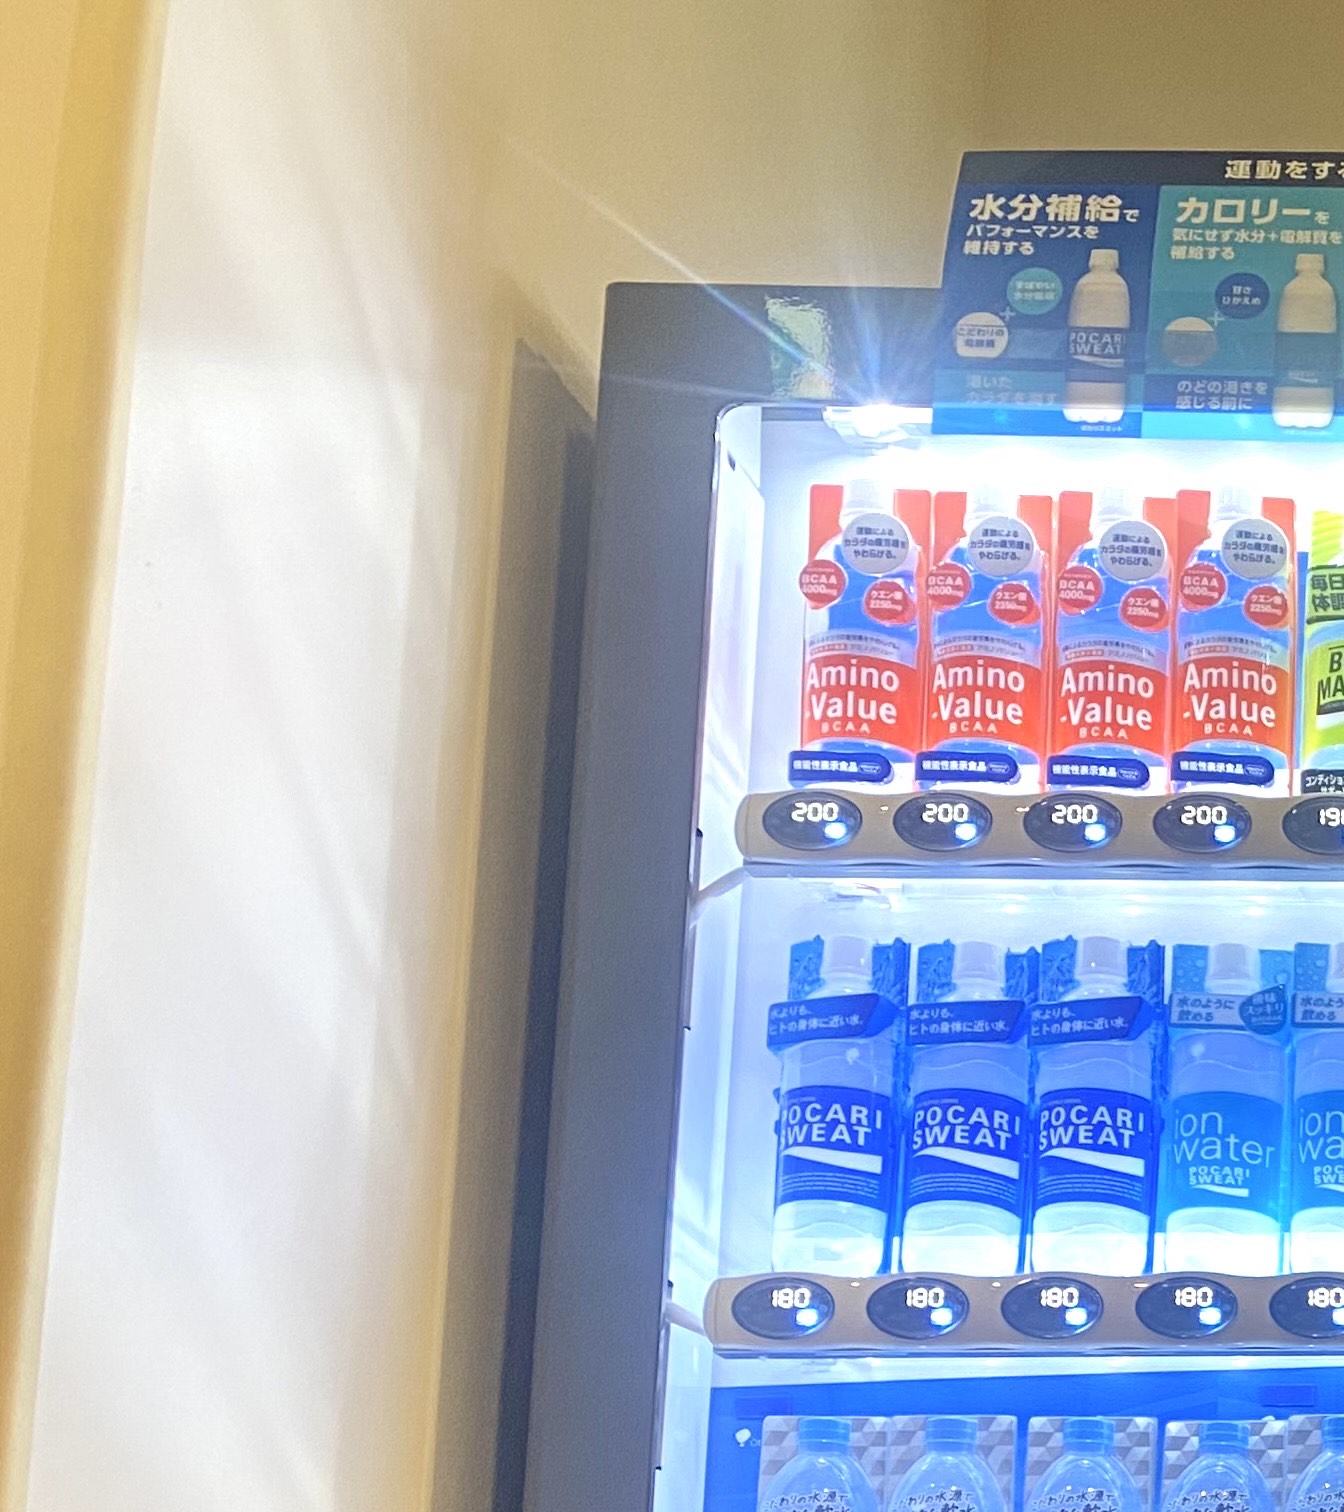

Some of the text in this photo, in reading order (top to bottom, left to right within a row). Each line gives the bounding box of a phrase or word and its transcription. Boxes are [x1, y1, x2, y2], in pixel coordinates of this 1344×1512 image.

[969, 194, 1139, 223] 水分補給で
[1175, 197, 1329, 224] カロリーを
[967, 224, 1099, 239] パフォーマンスを
[962, 241, 1034, 256] 維持する
[1170, 245, 1235, 260] 補給する
[806, 660, 899, 693] Amino
[1060, 665, 1154, 698] Amino
[810, 692, 897, 724] Value
[1067, 697, 1152, 730] Value
[822, 722, 871, 734] BCAA
[1079, 727, 1128, 739] BCAA
[791, 802, 838, 821] 200
[922, 803, 968, 822] 200
[1052, 804, 1098, 823] 200
[1181, 806, 1227, 824] 200
[914, 1106, 1020, 1134] POCARI
[1040, 1105, 1143, 1132] POCARI
[1176, 1110, 1222, 1138] ion
[913, 1126, 1012, 1150] SWEAT
[1039, 1124, 1135, 1149] SWEAT
[1174, 1135, 1274, 1168] water
[772, 1288, 811, 1308] 180
[1041, 1287, 1078, 1307] 180
[1175, 1286, 1213, 1307] 180
